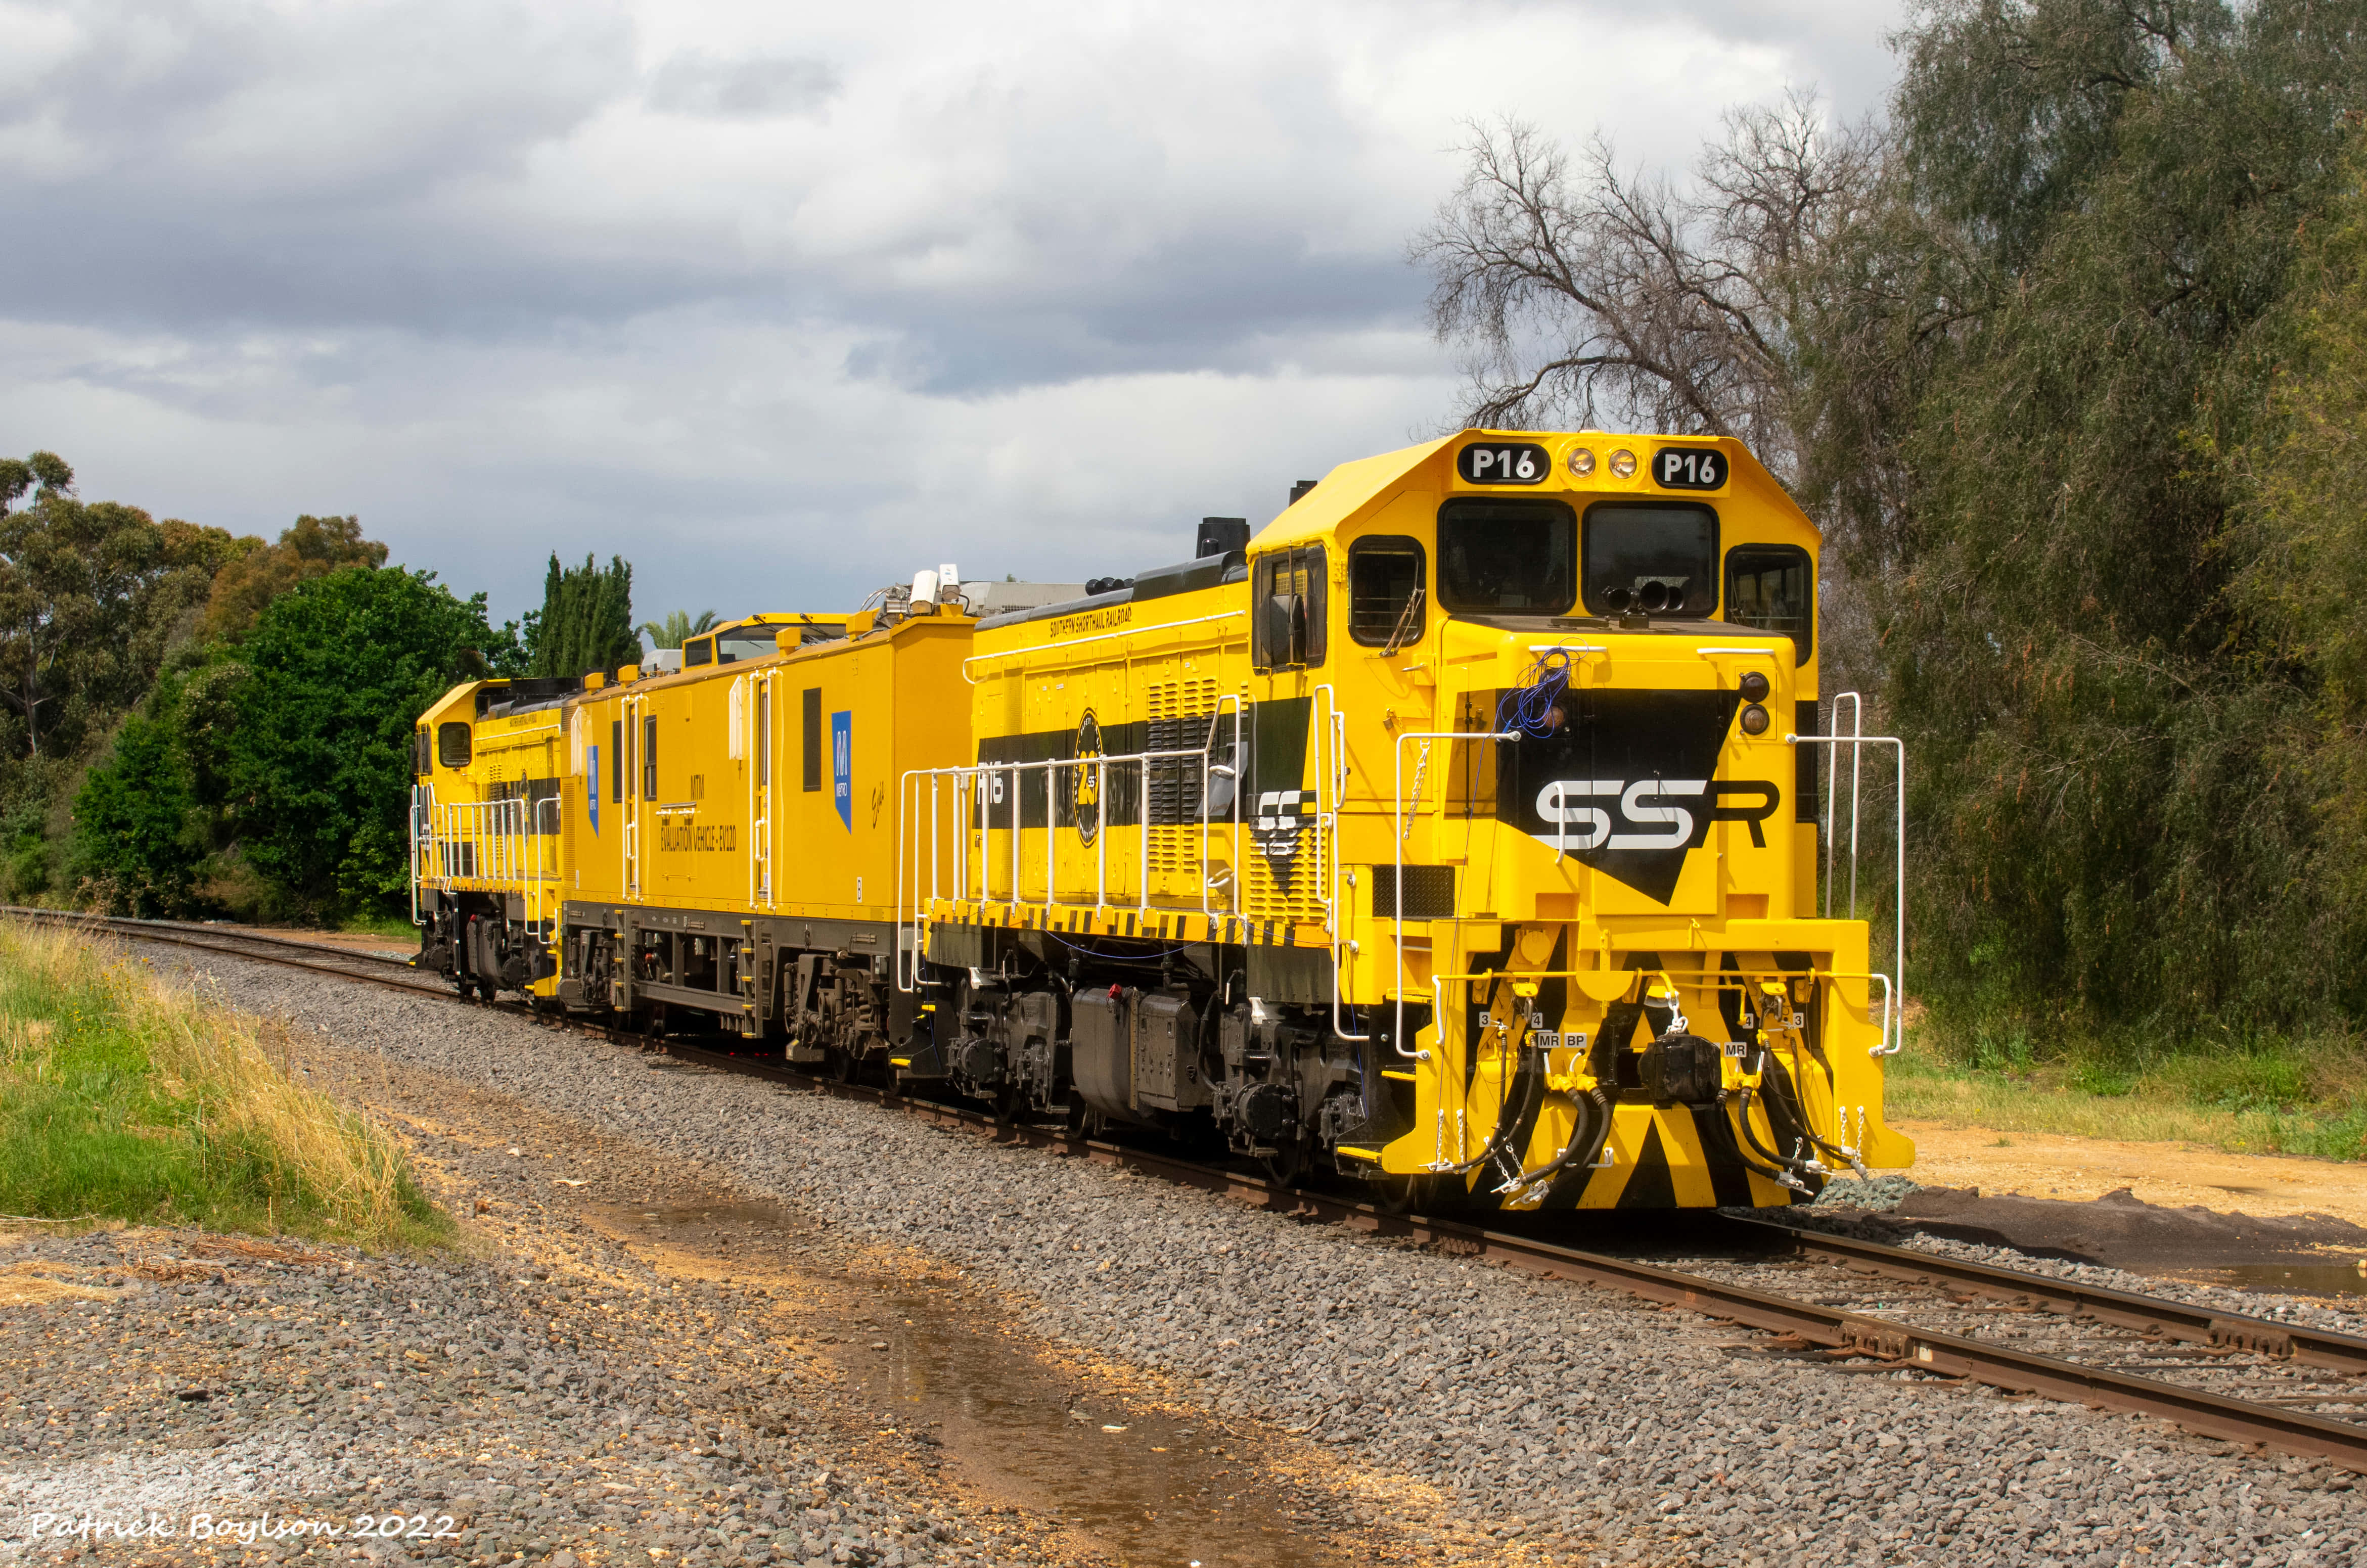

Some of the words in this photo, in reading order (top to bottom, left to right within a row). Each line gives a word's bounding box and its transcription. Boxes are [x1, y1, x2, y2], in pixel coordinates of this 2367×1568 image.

[1473, 449, 1535, 478] P16
[1664, 454, 1715, 483] P16
[1050, 617, 1075, 638] SOUTHERN
[1076, 612, 1105, 633] SHORTHAUL
[1106, 606, 1132, 628] RAILROAD
[691, 774, 704, 801] MTM
[836, 782, 847, 797] METRO
[1530, 780, 1780, 850] SSR
[661, 826, 692, 852] EVALUATION
[693, 825, 715, 852] VEHICLE
[720, 824, 736, 852] EV120
[1481, 1015, 1488, 1025] 3
[1533, 1017, 1540, 1026] 4
[1746, 1018, 1751, 1026] 4
[1795, 1016, 1801, 1026] 3
[1540, 1036, 1559, 1046] MR
[1567, 1036, 1584, 1046] BP
[1726, 1045, 1745, 1055] MR
